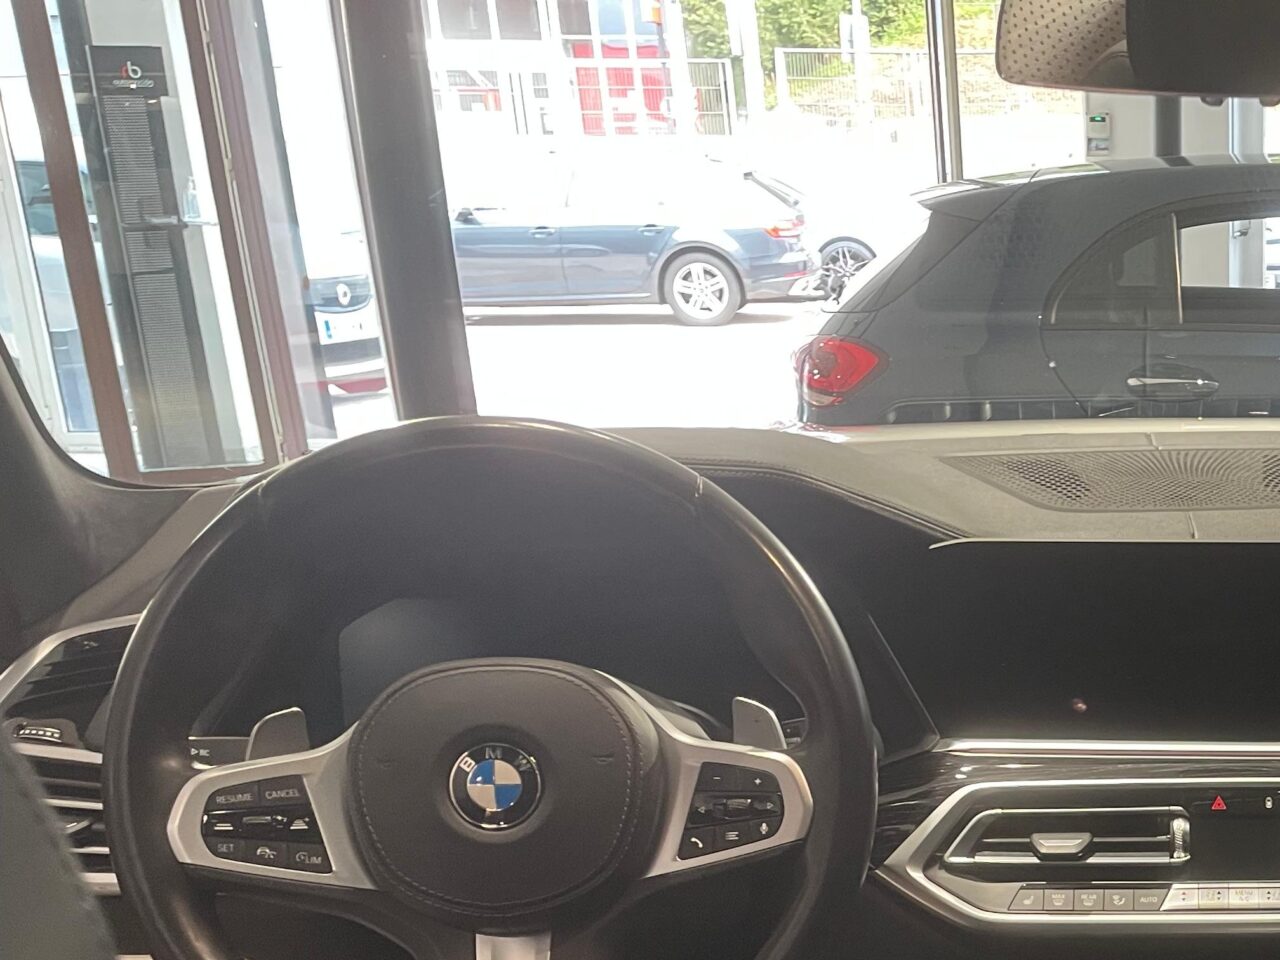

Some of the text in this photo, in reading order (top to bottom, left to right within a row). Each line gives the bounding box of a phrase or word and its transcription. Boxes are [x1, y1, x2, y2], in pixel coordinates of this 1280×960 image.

[459, 747, 532, 773] BMW
[216, 793, 253, 804] RESUME
[265, 788, 300, 799] CANCEL
[217, 843, 234, 853] SET
[305, 856, 322, 864] LIM
